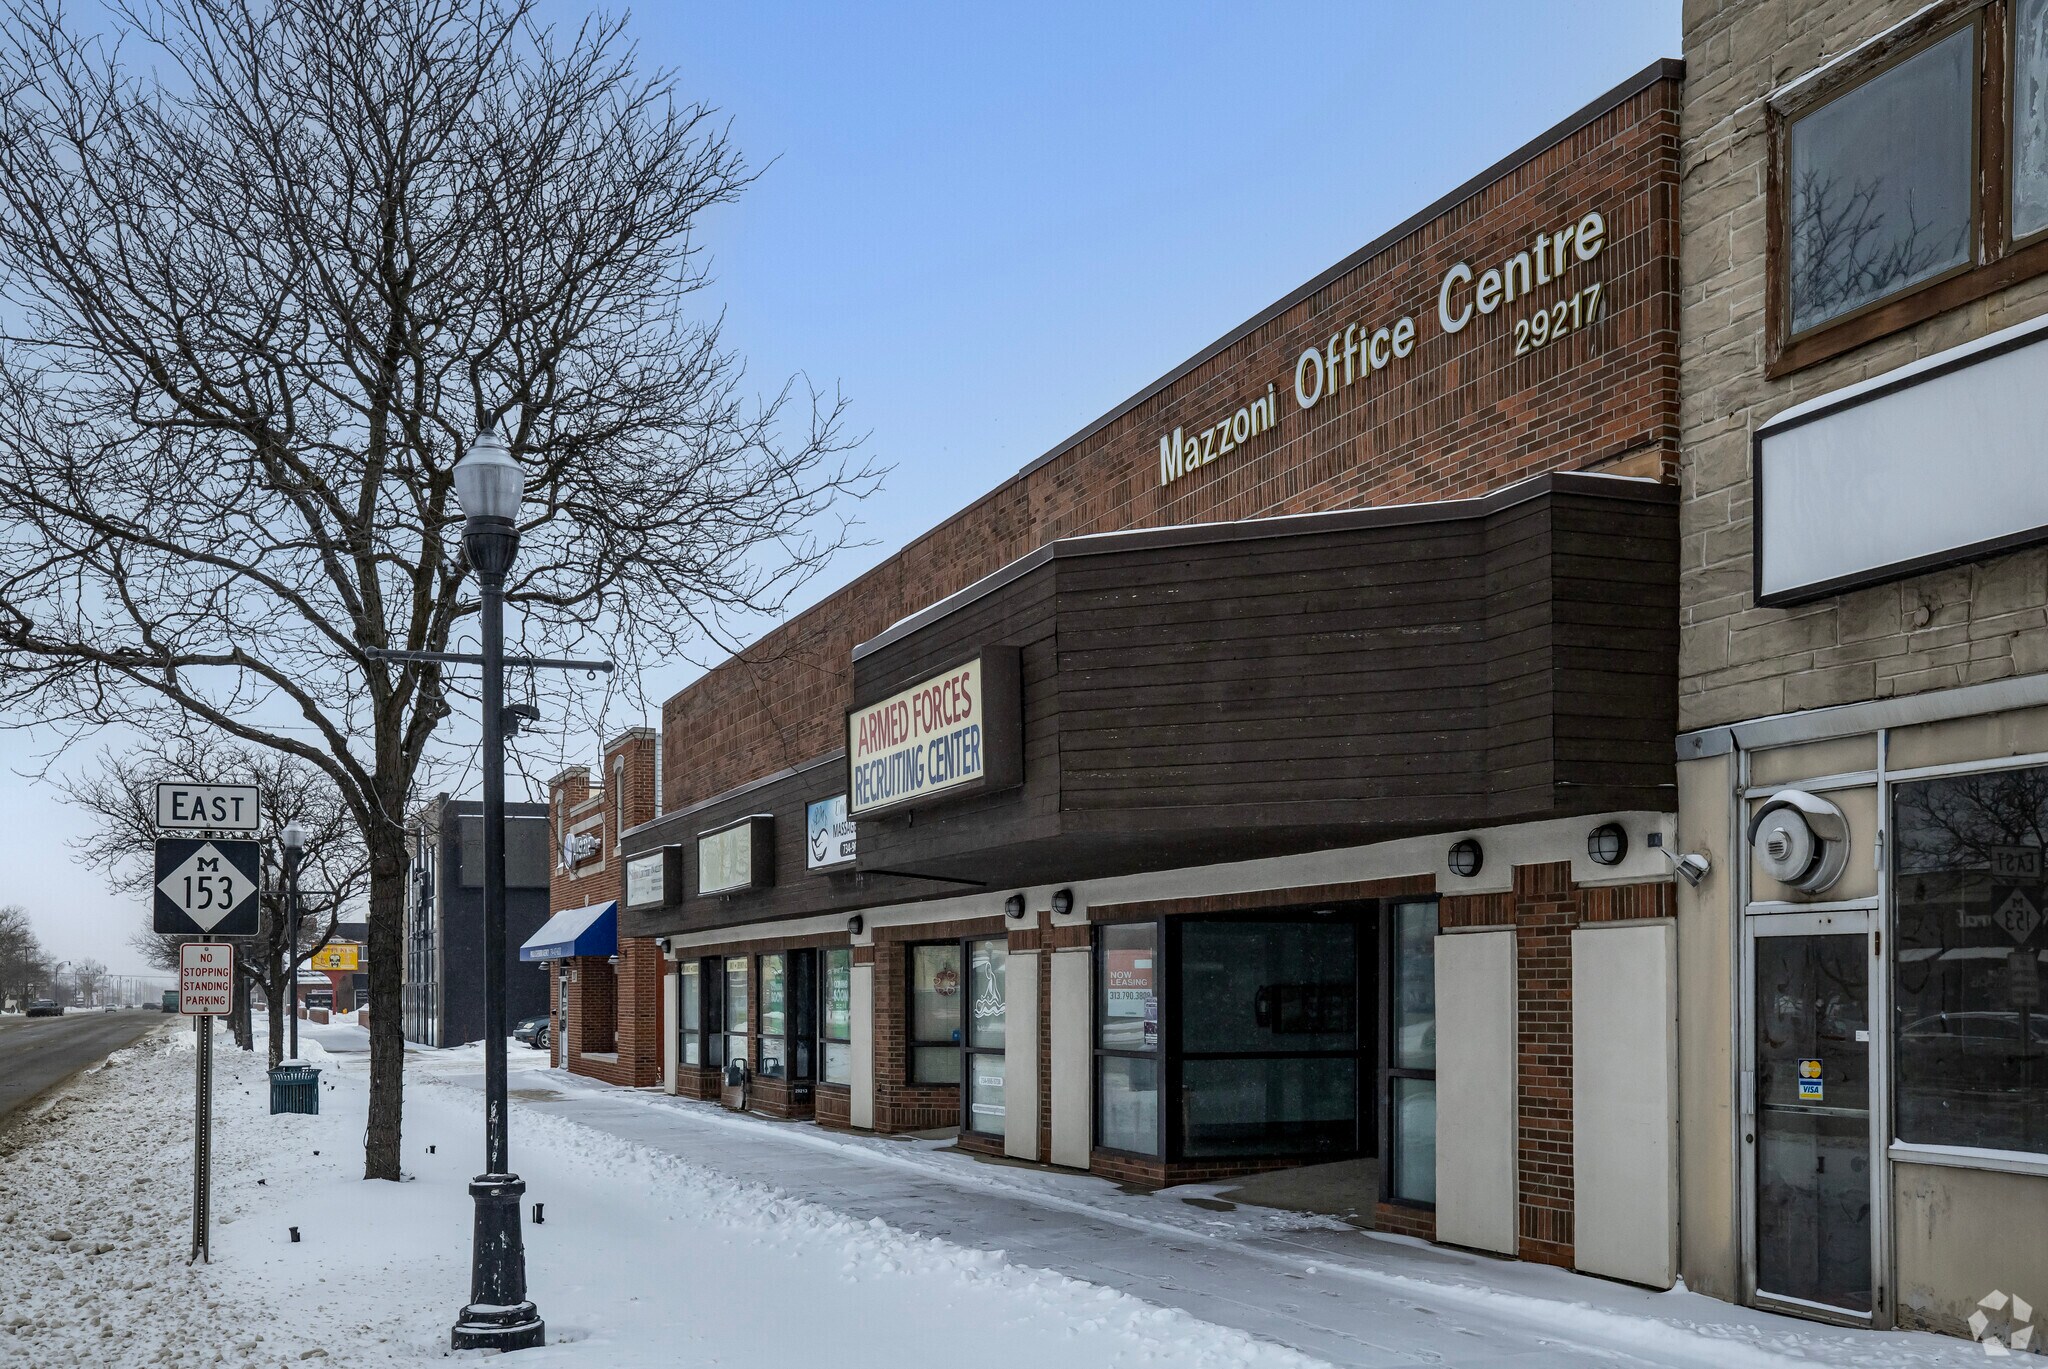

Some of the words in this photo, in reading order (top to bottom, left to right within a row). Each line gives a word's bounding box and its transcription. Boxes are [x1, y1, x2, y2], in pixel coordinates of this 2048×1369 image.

[1513, 282, 1604, 357] 29217
[1159, 383, 1277, 487] Mazzoni
[1294, 322, 1417, 410] Office
[1438, 211, 1607, 334] Centre
[858, 699, 909, 758] ARMED
[913, 672, 972, 737] FORCES
[855, 744, 924, 806] RECRUITING
[928, 724, 981, 788] CENTER
[172, 791, 244, 822] EAST
[197, 857, 219, 872] M
[183, 876, 233, 910] 153
[200, 953, 213, 963] NO
[184, 967, 229, 977] STOPPING
[184, 981, 229, 991] STANDING
[186, 995, 226, 1005] PARKING
[1803, 1085, 1819, 1093] VISA
